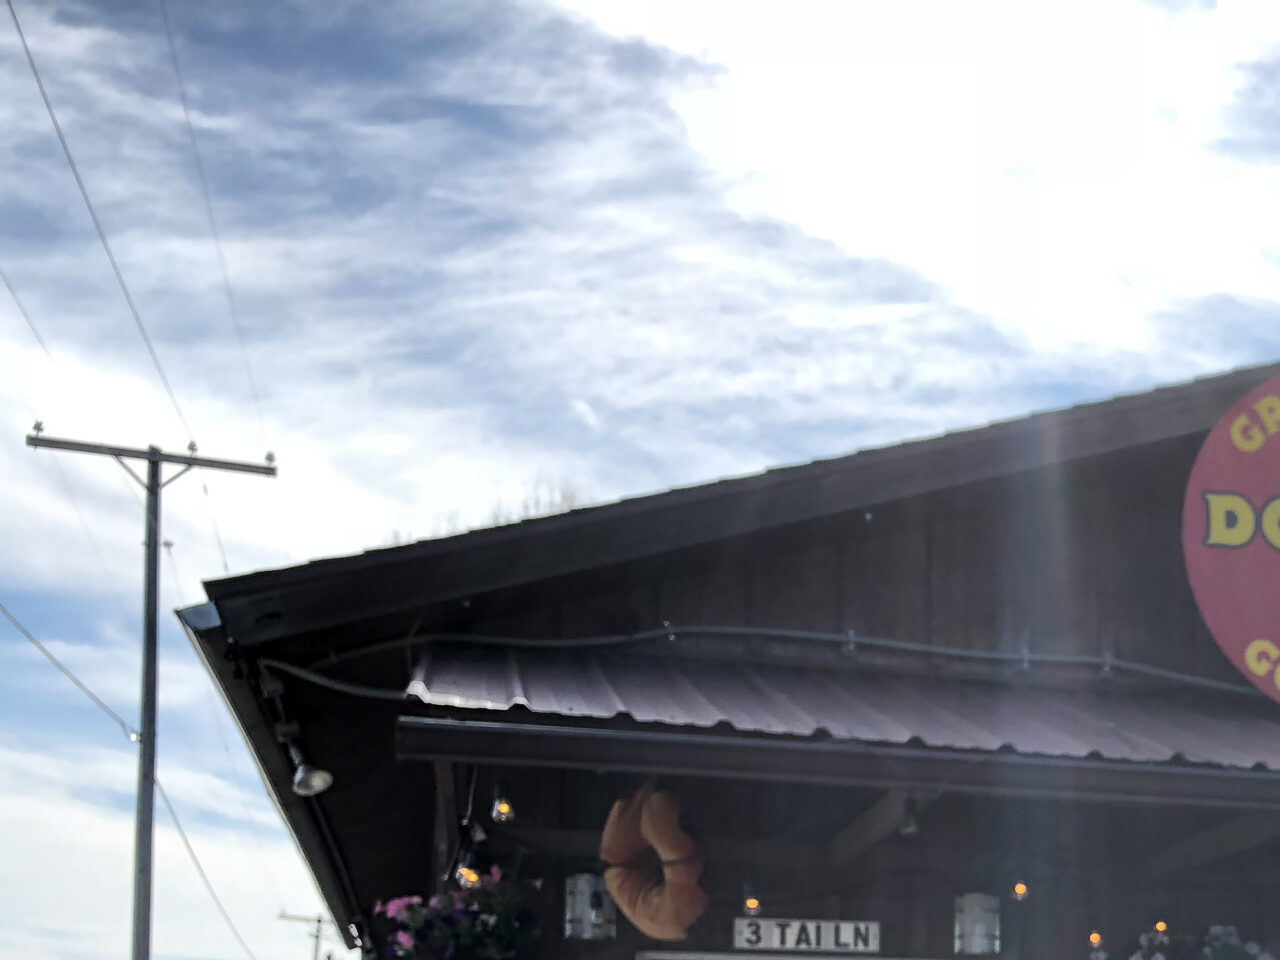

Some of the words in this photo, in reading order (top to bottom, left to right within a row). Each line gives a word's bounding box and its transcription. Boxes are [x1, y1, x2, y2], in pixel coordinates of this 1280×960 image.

[745, 921, 762, 946] 3
[775, 923, 822, 947] TAI
[834, 924, 870, 948] LN
